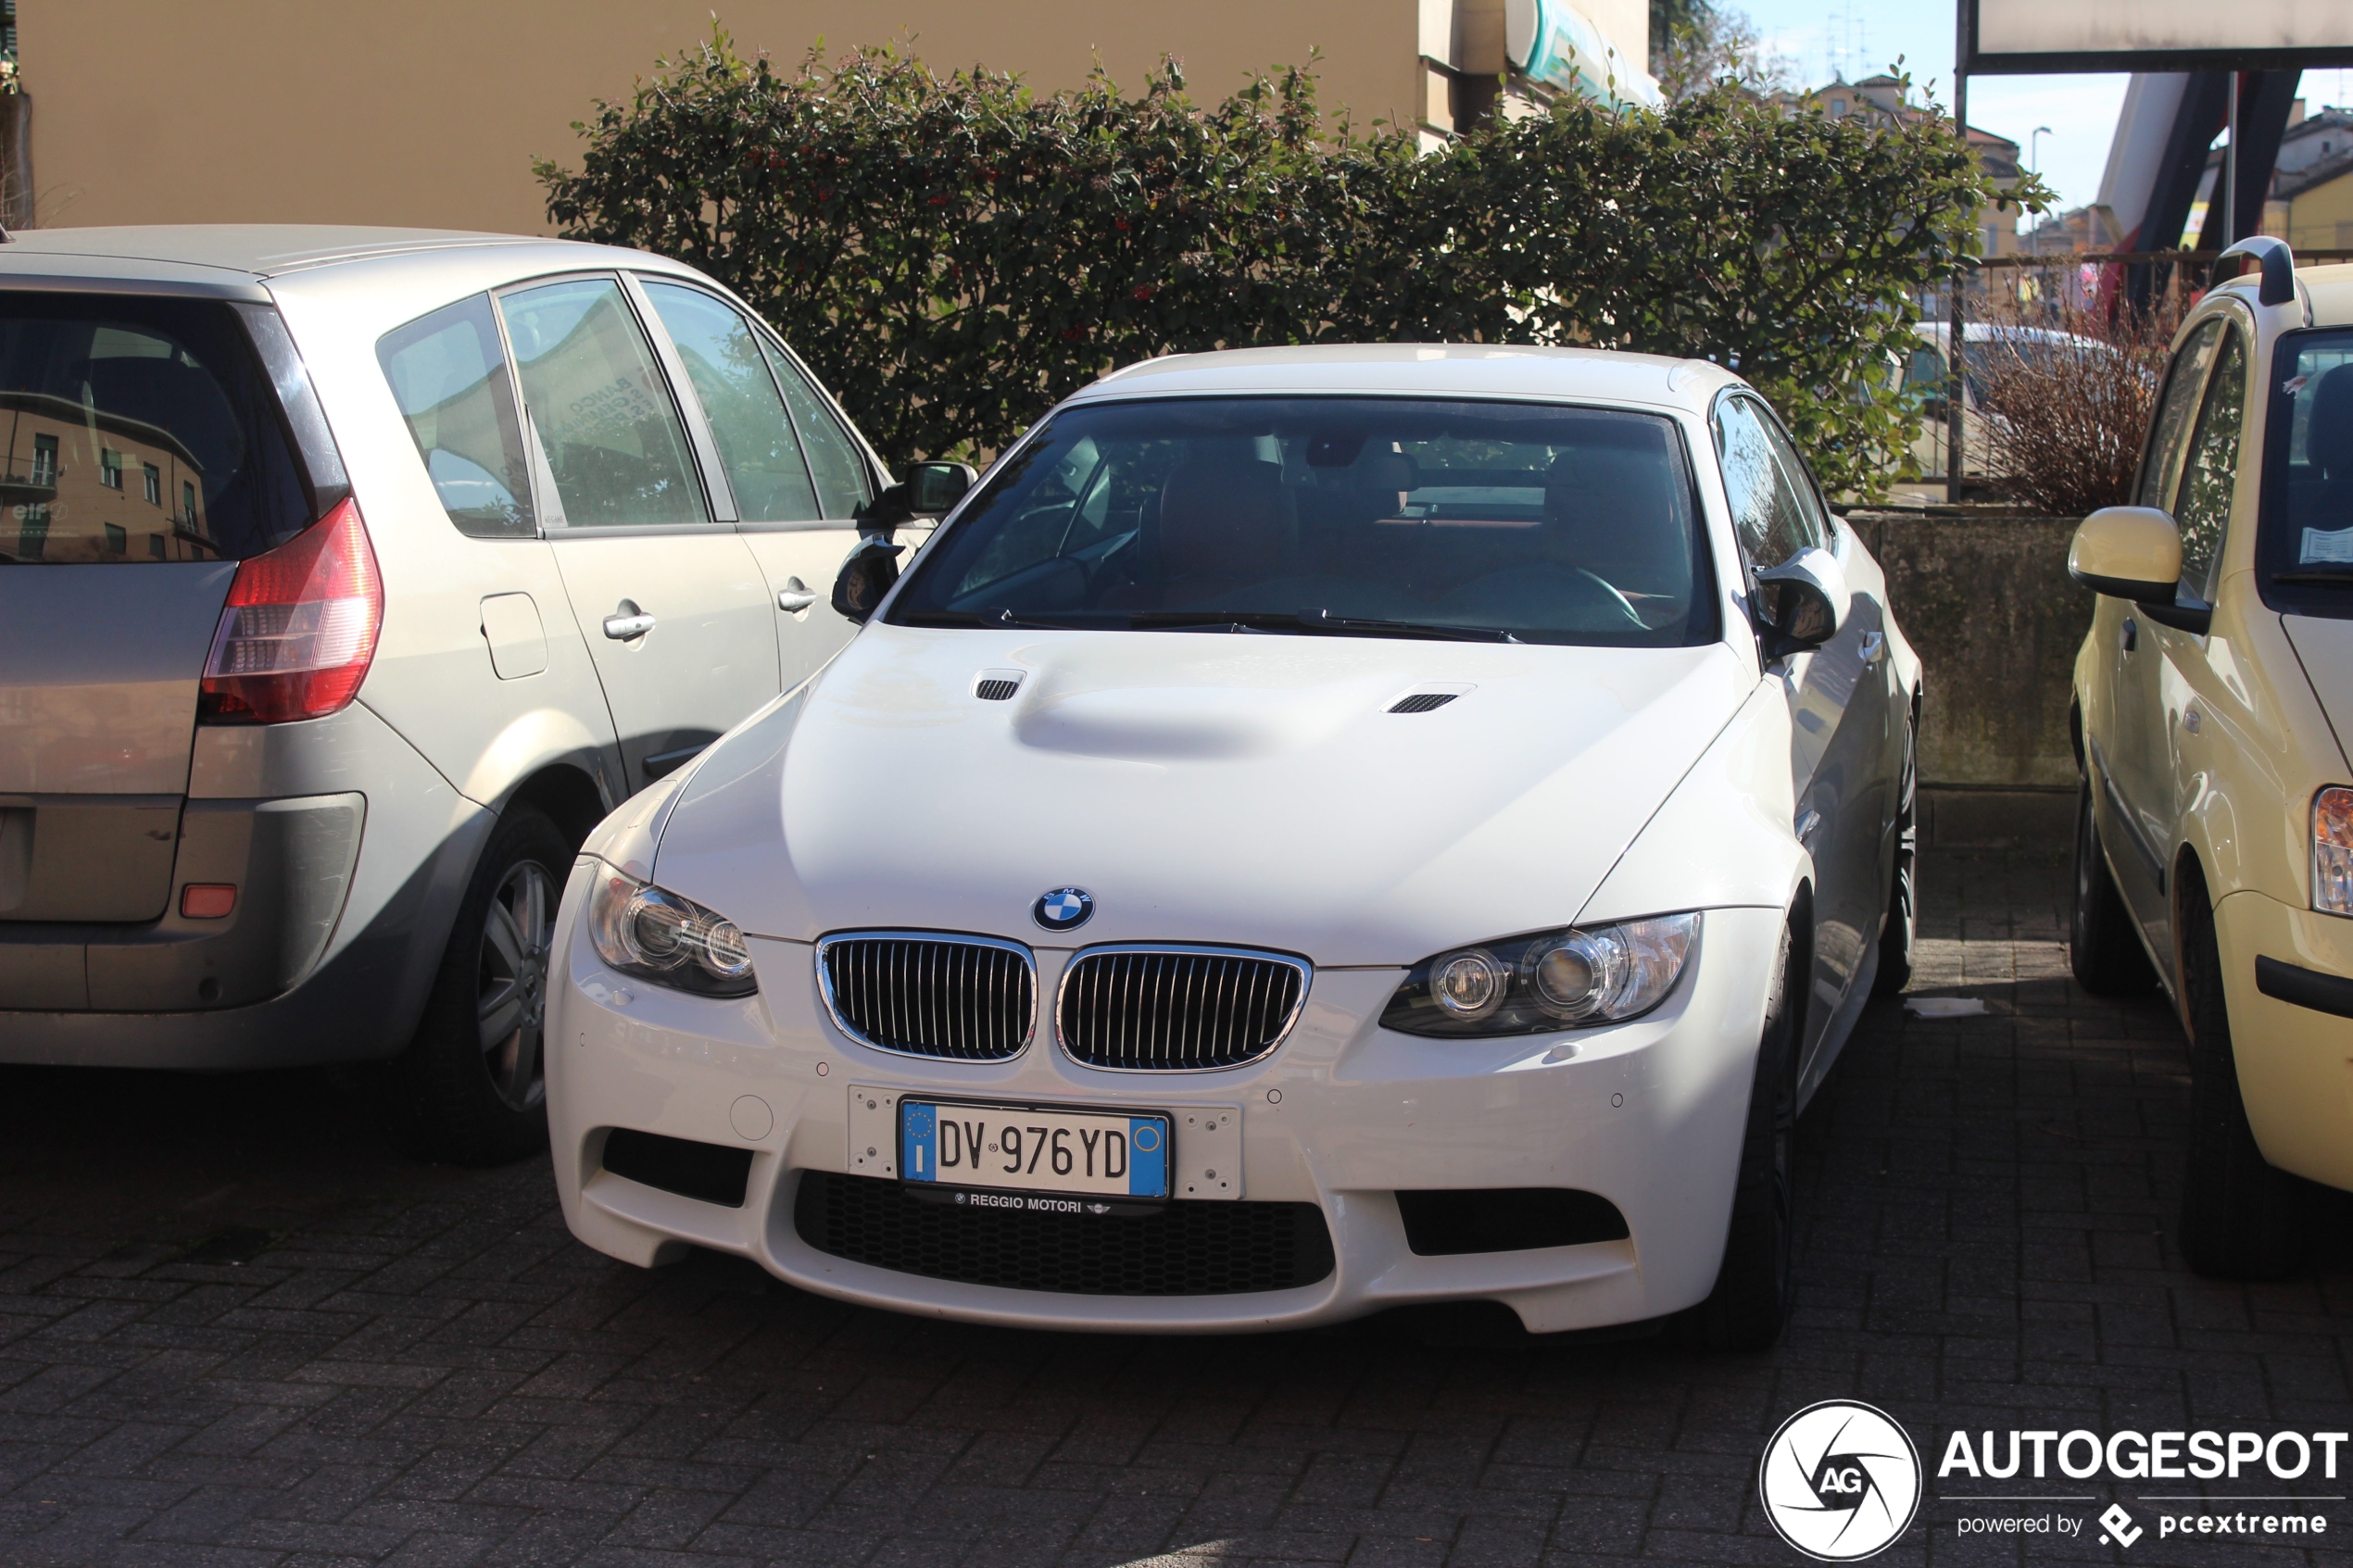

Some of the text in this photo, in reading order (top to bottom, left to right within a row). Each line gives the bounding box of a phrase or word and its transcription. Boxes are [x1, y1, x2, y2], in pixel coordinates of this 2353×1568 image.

[12, 503, 46, 520] elf
[1043, 888, 1091, 903] BMW
[970, 1194, 1081, 1213] REGGIO MOTORI
